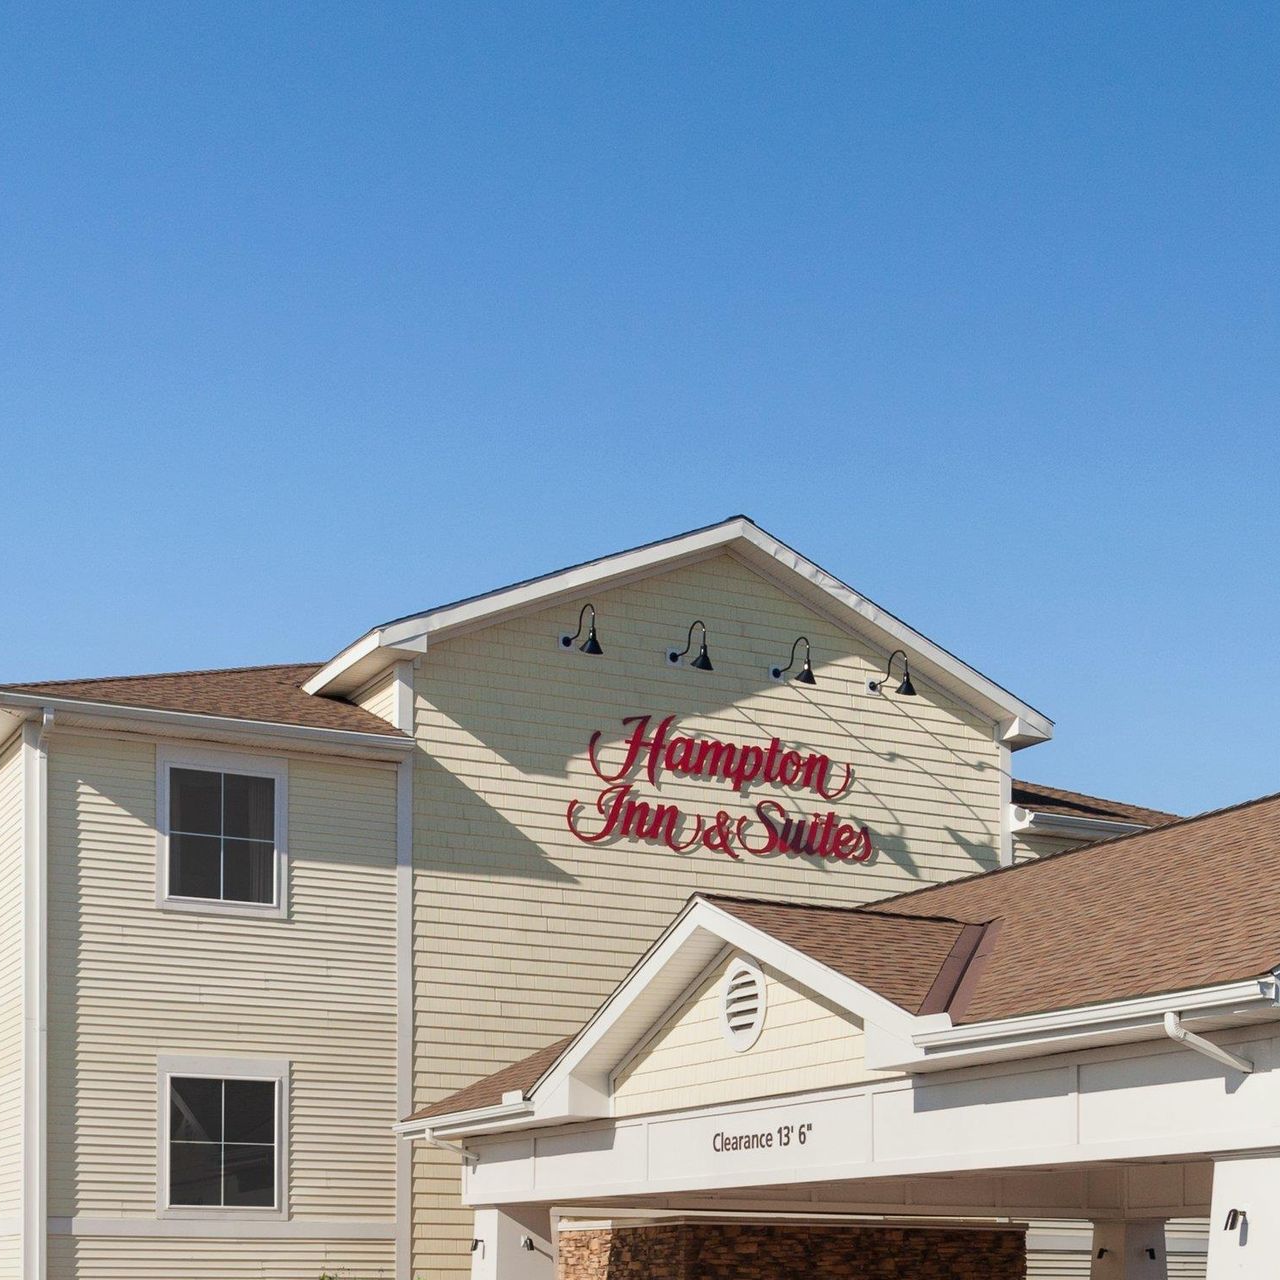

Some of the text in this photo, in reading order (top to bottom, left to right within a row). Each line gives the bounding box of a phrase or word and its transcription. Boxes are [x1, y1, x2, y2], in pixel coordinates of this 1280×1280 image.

[589, 715, 851, 800] Hampton
[567, 784, 872, 862] Inn & Suites
[713, 1123, 812, 1152] Clearance 13' 6"
